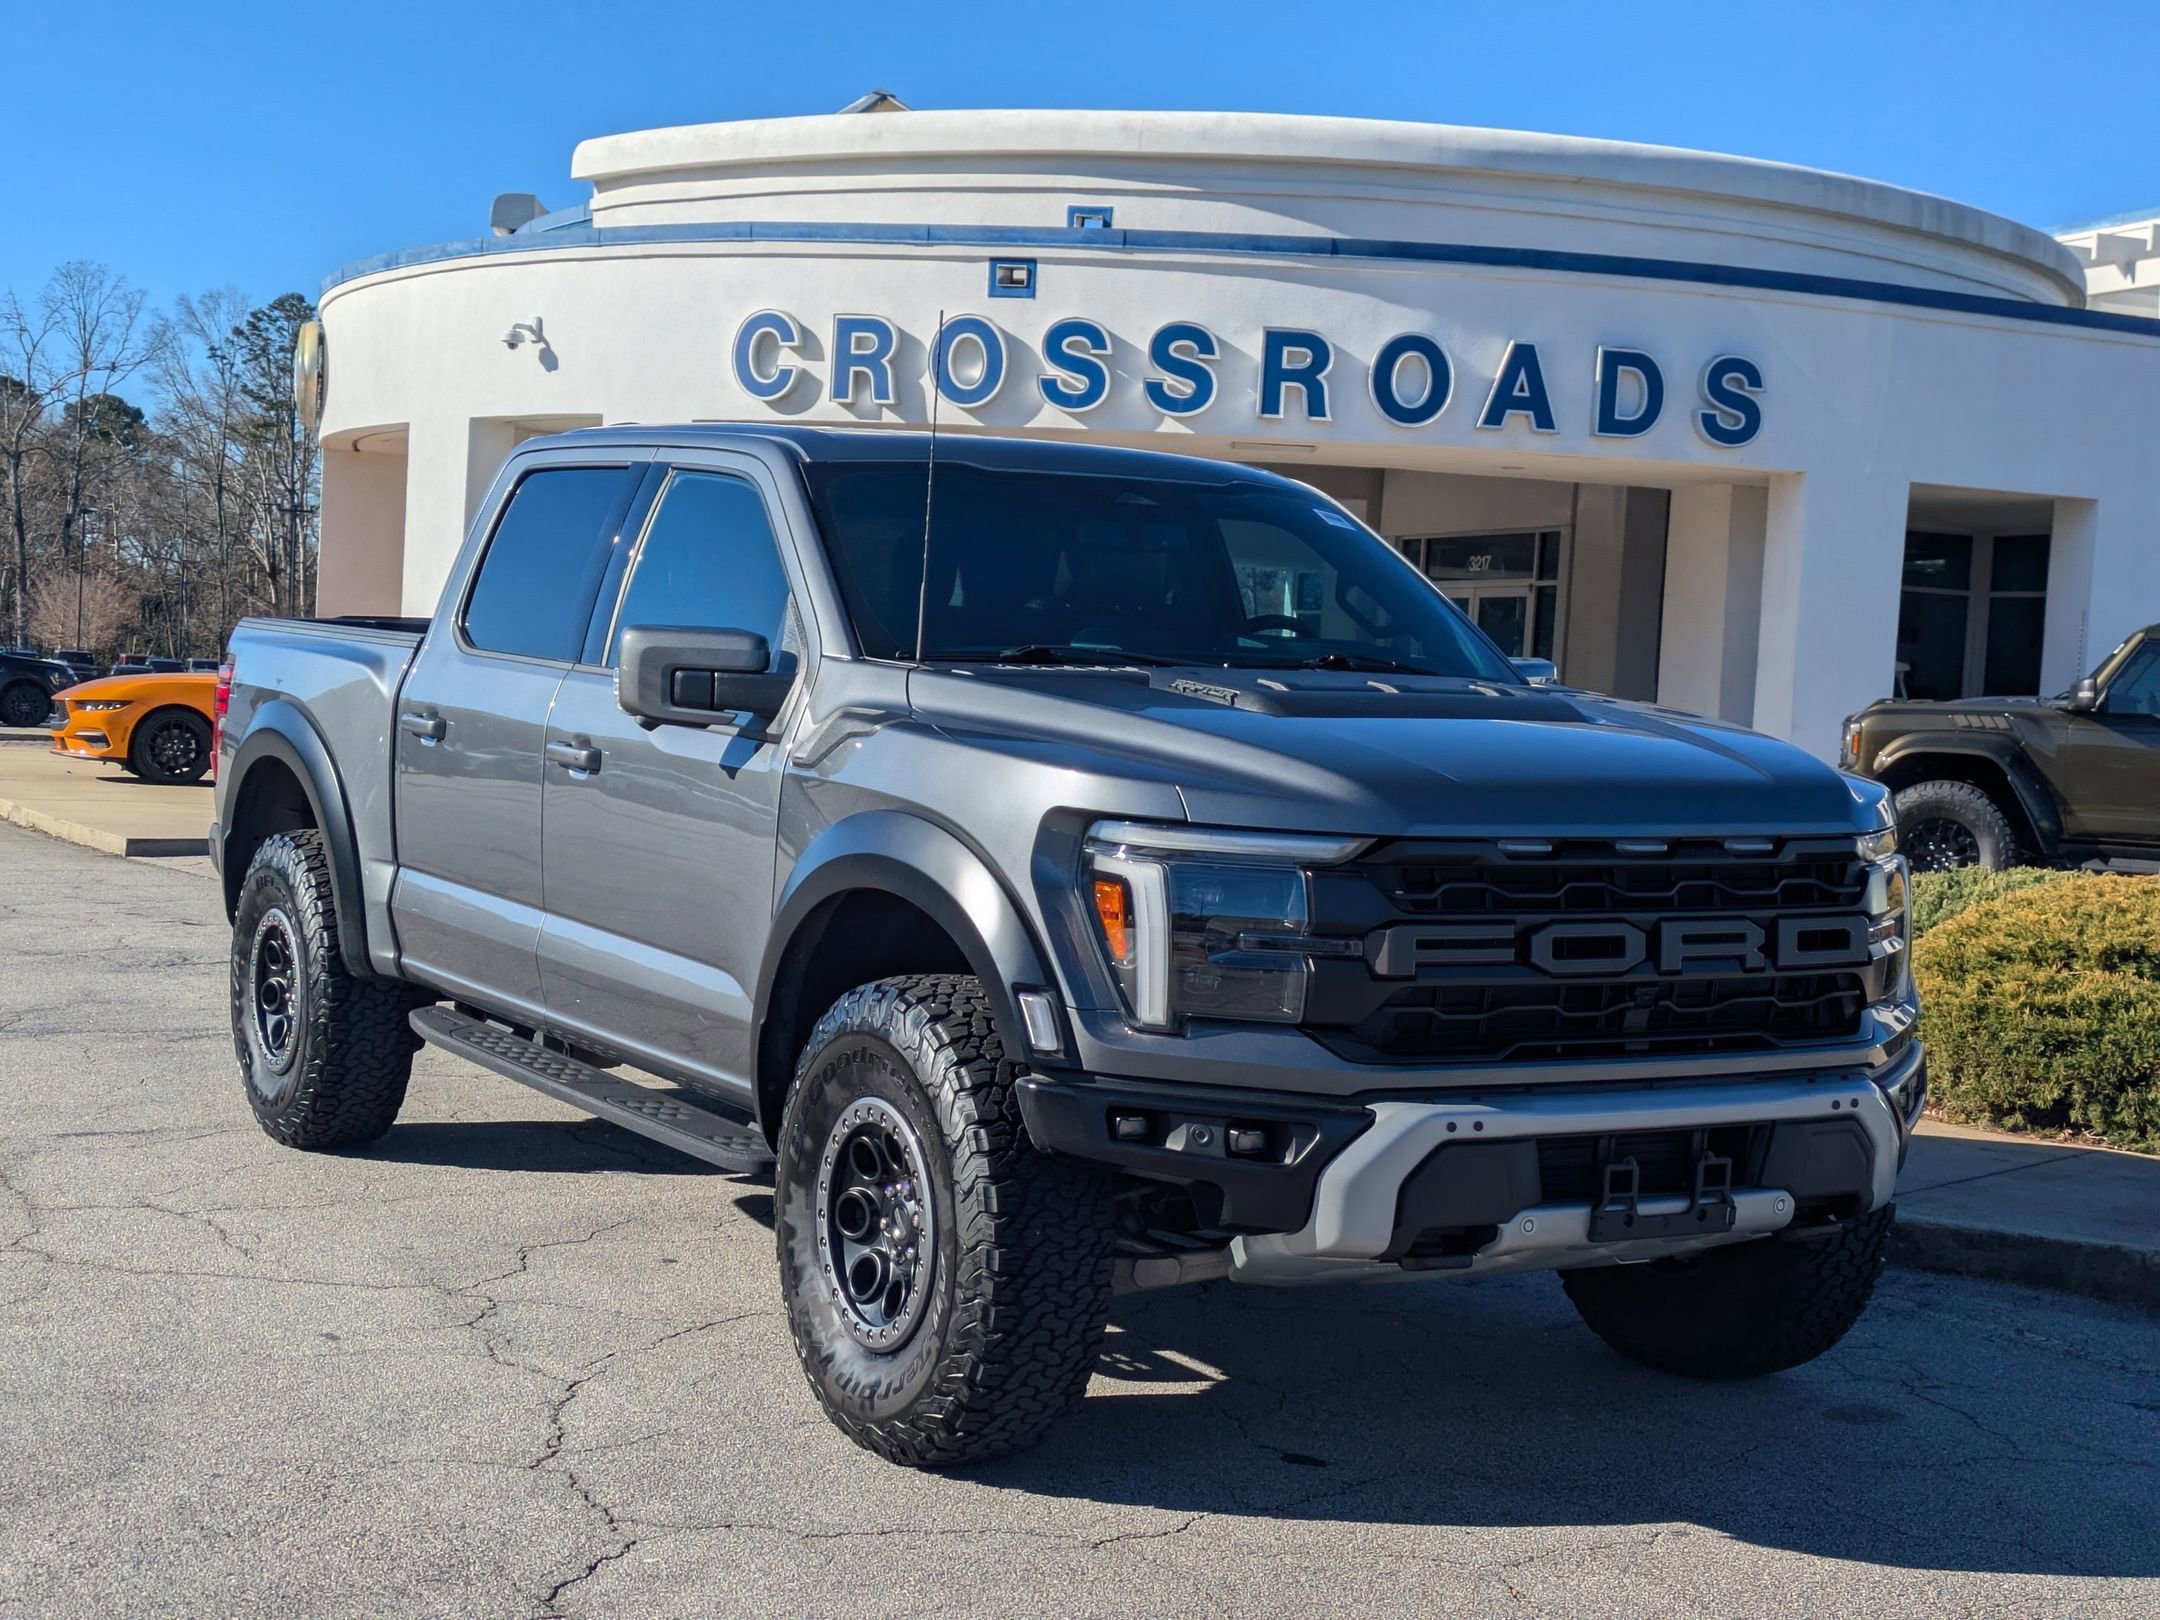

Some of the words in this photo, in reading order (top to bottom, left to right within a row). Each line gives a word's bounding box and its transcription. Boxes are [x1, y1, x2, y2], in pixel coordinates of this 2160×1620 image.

[731, 308, 1766, 449] CROSSROADS
[1468, 555, 1491, 572] 3217
[1366, 915, 1870, 977] FORD
